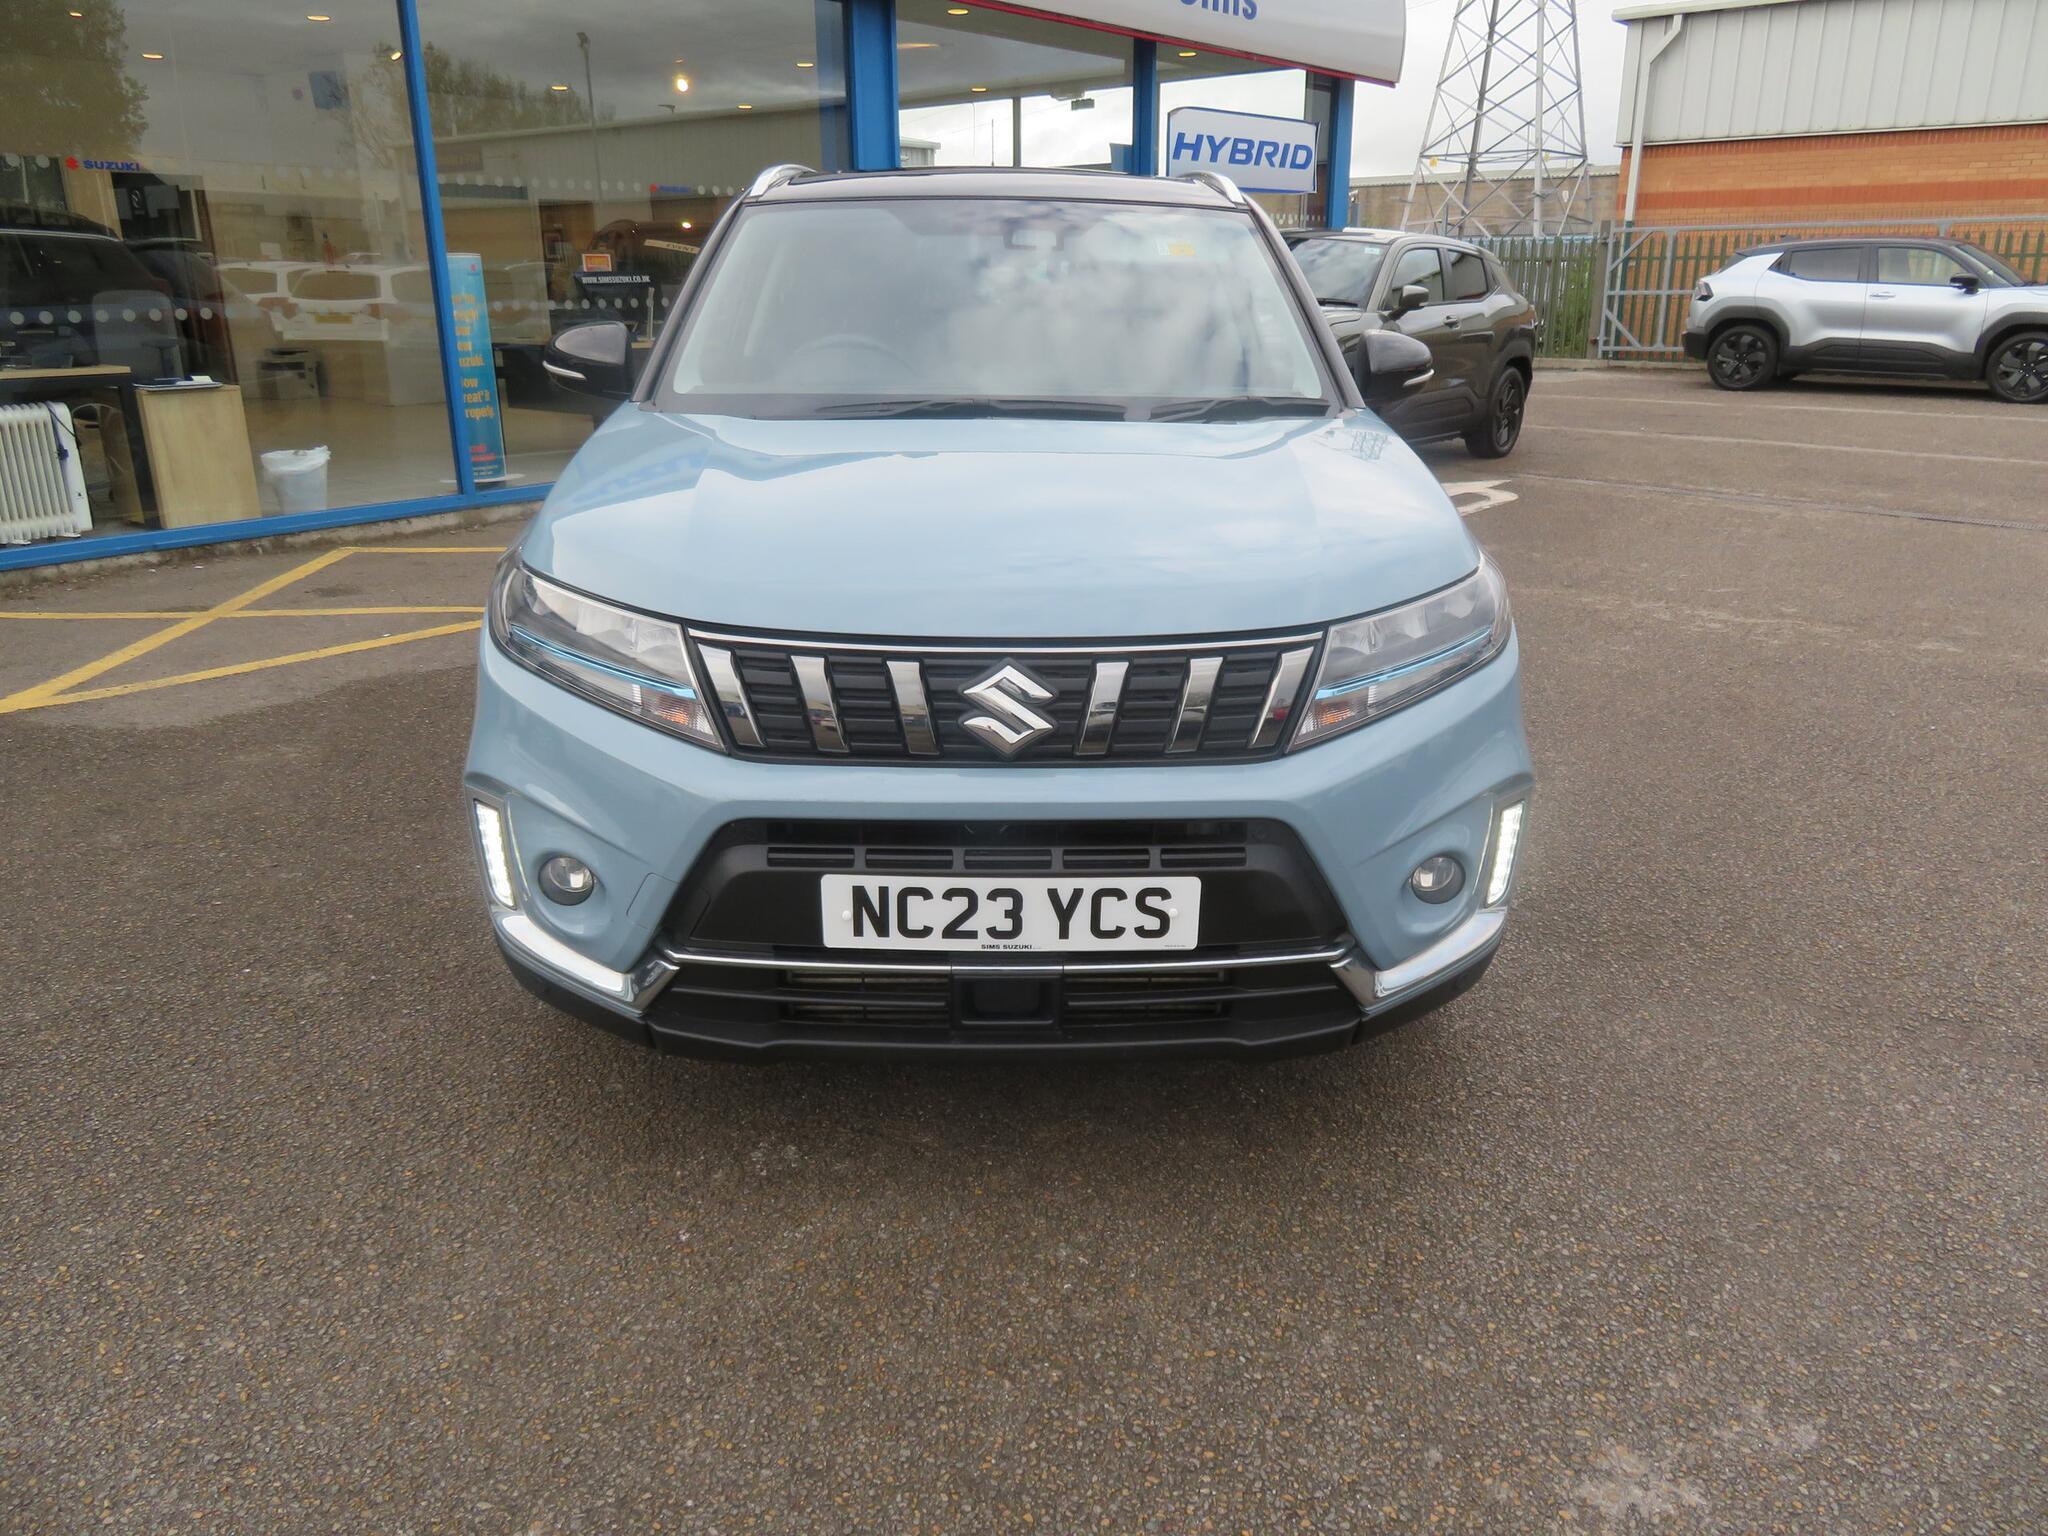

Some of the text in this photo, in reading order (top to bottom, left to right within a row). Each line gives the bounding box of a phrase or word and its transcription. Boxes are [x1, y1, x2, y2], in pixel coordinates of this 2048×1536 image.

[83, 159, 141, 171] SUZUKI
[1172, 132, 1314, 170] HYBRID
[851, 885, 1173, 940] NC23 YCS
